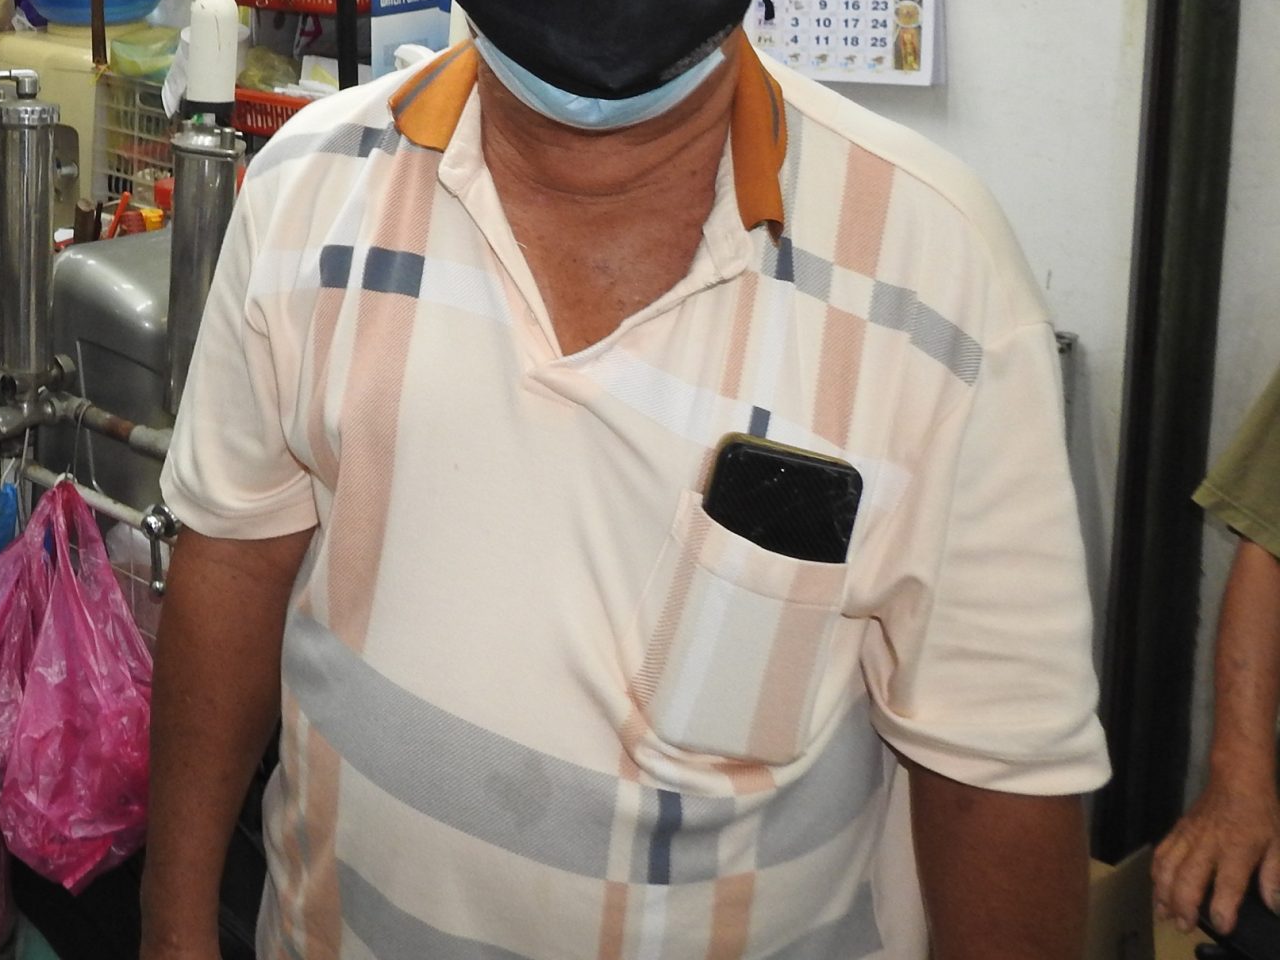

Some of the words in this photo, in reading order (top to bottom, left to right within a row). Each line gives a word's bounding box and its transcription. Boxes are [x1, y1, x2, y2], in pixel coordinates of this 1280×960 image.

[819, 1, 827, 10] 9
[844, 1, 860, 10] 16
[871, 1, 888, 11] 23
[790, 18, 799, 27] 3
[815, 18, 831, 28] 10
[843, 18, 859, 28] 17
[871, 19, 888, 29] 24
[790, 35, 798, 44] 4
[815, 36, 830, 45] 11
[843, 36, 859, 46] 18
[870, 37, 887, 47] 25
